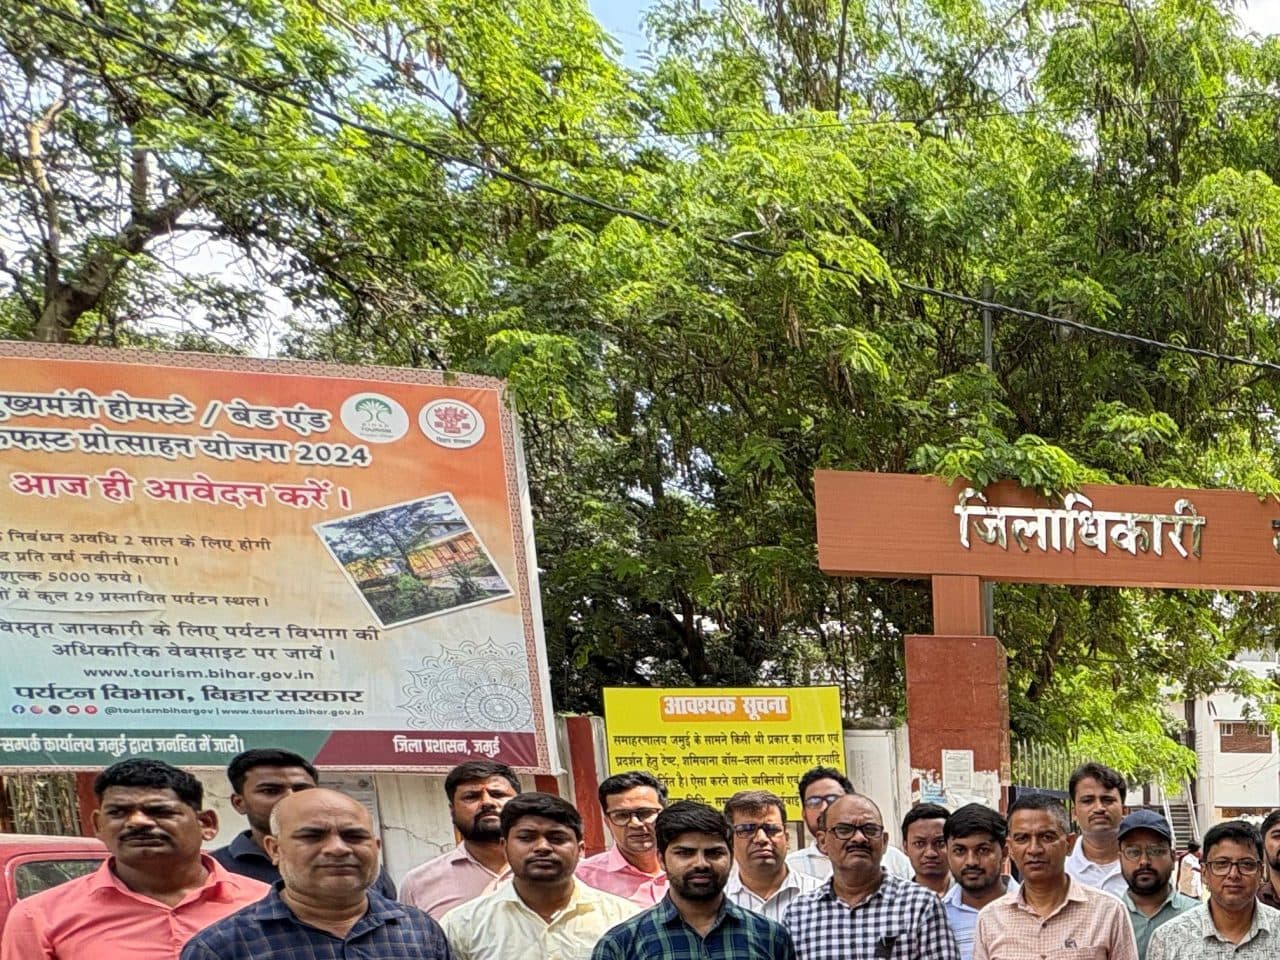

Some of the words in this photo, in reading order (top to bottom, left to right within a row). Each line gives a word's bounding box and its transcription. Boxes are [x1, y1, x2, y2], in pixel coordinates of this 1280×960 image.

[0, 391, 98, 417] ख्यमंत्री
[104, 393, 195, 420] होमस्टे
[229, 400, 275, 426] बेड
[284, 405, 327, 432] एंड
[79, 426, 194, 456] प्रोत्साहन
[201, 433, 287, 458] योजना
[300, 444, 369, 464] 2024
[13, 474, 89, 496] आज
[97, 470, 133, 499] ही
[147, 473, 266, 507] आवेदन
[274, 480, 330, 508] करें
[954, 487, 1207, 559] जिलाधिकारी
[8, 528, 64, 543] निबंधन
[71, 531, 118, 545] अवधि
[124, 536, 134, 545] 2
[138, 536, 174, 547] साल
[178, 534, 196, 548] के
[201, 536, 235, 552] लिए
[238, 537, 272, 550] होगी
[15, 548, 44, 562] प्रति
[48, 549, 75, 563] वर्ष
[48, 572, 91, 583] 5000
[16, 587, 31, 600] में
[35, 590, 68, 605] कुल
[74, 591, 94, 602] 29
[99, 590, 167, 604] प्रस्तावित
[171, 592, 219, 606] पर्यटन
[58, 620, 144, 637] जानकारी
[149, 620, 172, 637] के
[176, 621, 220, 641] लिए
[222, 622, 281, 639] पर्यटन
[286, 623, 349, 641] विभाग
[353, 626, 381, 641] की
[52, 640, 161, 659] अधिकारिक
[165, 641, 248, 662] वेबसाइट
[252, 647, 277, 660] पर
[282, 645, 323, 661] जायें
[83, 667, 315, 682] www.tourism.bihar.gov.in
[13, 682, 96, 701] पर्यटन
[100, 683, 195, 703] विभाग,
[201, 684, 272, 703] बिहार
[273, 688, 365, 703] सरकार
[105, 705, 214, 717] @tourismbihargov
[221, 706, 365, 717] www.tourism.bihar.gov.in
[664, 695, 737, 716] आवश्यक
[741, 695, 788, 721] सूचना
[41, 732, 95, 753] कार्यालय
[95, 732, 128, 757] जमुई
[127, 737, 154, 755] द्वारा
[152, 733, 197, 753] जनहित
[196, 733, 212, 753] में
[392, 734, 423, 753] जिला
[471, 735, 500, 757] जमुई
[613, 735, 667, 747] समाहरणालय
[670, 731, 691, 750] जमुई
[693, 732, 701, 745] के
[704, 732, 728, 745] सामने
[730, 731, 751, 745] किसी
[754, 731, 764, 745] भी
[767, 734, 789, 745] प्रकार
[791, 734, 802, 745] का
[615, 752, 643, 767] प्रदर्शन
[645, 753, 659, 771] हेतु
[710, 773, 729, 786] करने
